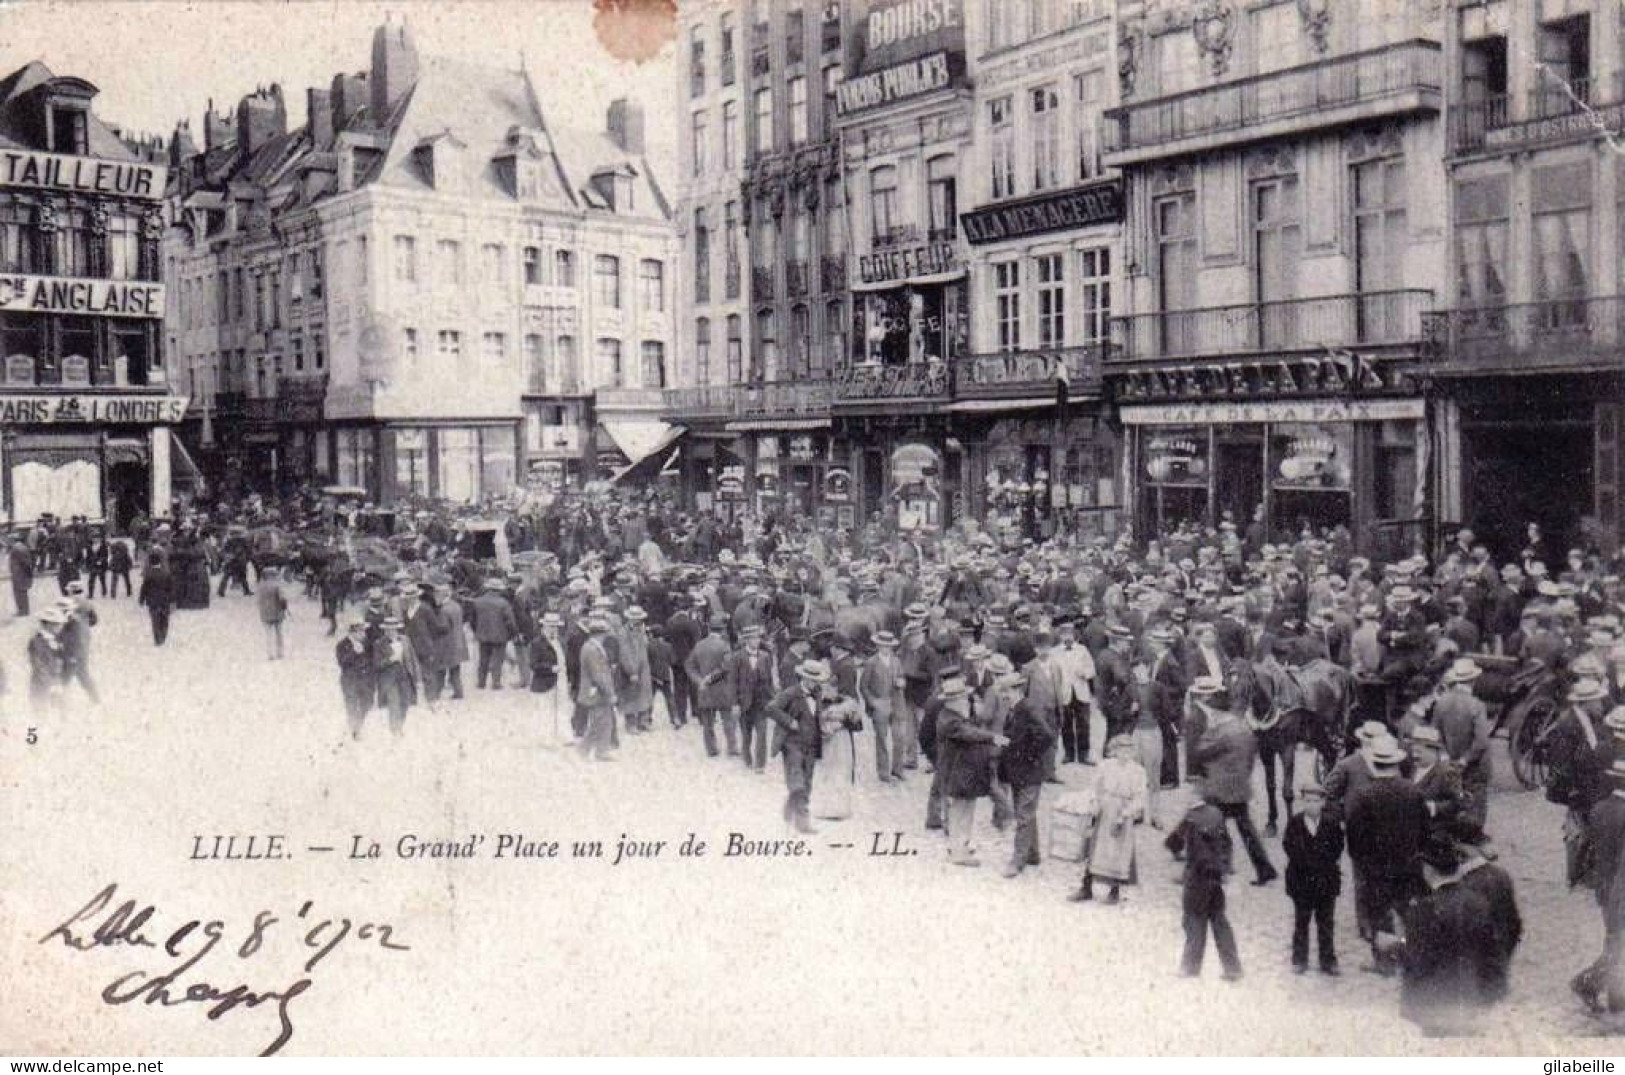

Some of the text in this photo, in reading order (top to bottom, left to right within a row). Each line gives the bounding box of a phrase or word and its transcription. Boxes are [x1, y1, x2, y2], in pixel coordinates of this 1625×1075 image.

[869, 0, 959, 50] BOURSE
[5, 153, 153, 193] TAILLEUR
[860, 244, 952, 284] COIFFEUR
[32, 281, 162, 314] ANGLAISE
[1302, 353, 1384, 390] PAX
[0, 398, 49, 421] ARIS
[94, 398, 181, 422] LONDRES
[26, 727, 38, 745] 5
[189, 835, 293, 860] LILLE.
[349, 835, 381, 859] La
[494, 834, 560, 858] Place
[572, 841, 603, 858] un
[613, 833, 667, 866] jour
[679, 832, 706, 857] de
[723, 831, 813, 857] Bourse.
[869, 831, 919, 857] LL.
